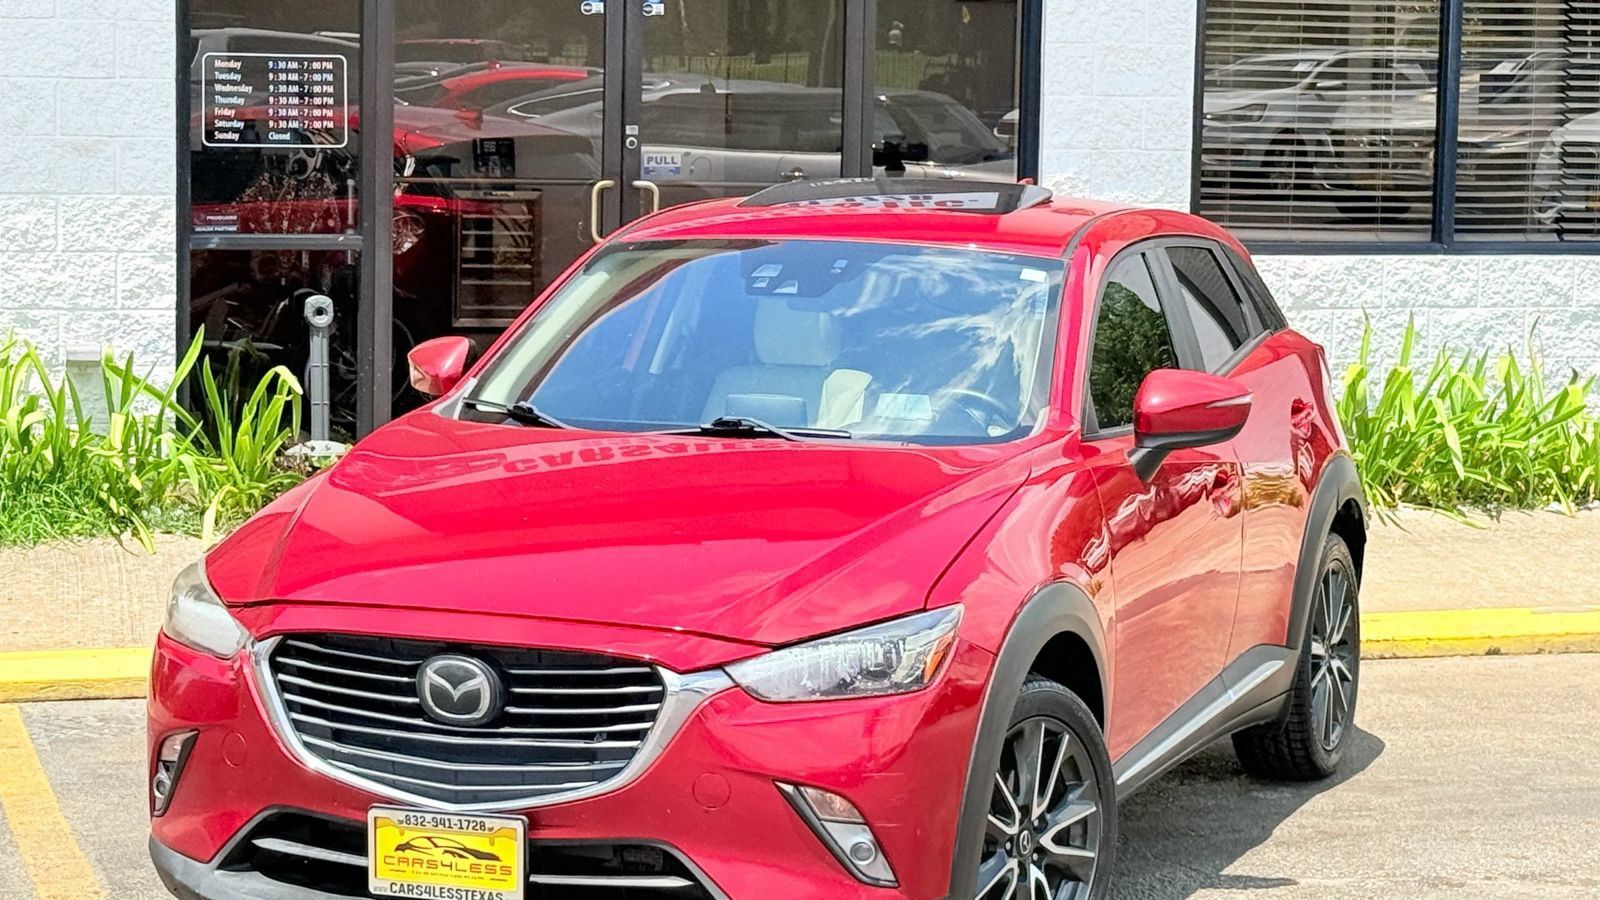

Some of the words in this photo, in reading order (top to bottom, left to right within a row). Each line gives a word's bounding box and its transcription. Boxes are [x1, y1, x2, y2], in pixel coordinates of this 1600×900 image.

[214, 59, 242, 70] Monday
[287, 61, 298, 70] AM
[322, 61, 333, 70] PM
[214, 72, 242, 82] Tuesday
[288, 73, 299, 81] AM
[323, 73, 333, 81] PM
[214, 84, 254, 94] Wednesday
[288, 85, 299, 93] AM
[323, 85, 334, 93] PM
[214, 96, 245, 106] Thursday
[288, 97, 299, 105] AM
[323, 97, 334, 105] PM
[214, 108, 236, 118] Friday
[288, 109, 299, 117] AM
[323, 109, 333, 117] PM
[214, 120, 244, 130] Saturday
[214, 131, 240, 141] Sunday
[268, 132, 290, 140] Closed
[646, 156, 678, 165] PULL
[404, 814, 486, 832] 832-941-1728
[384, 855, 512, 876] CARS4LESS
[390, 882, 503, 900] CARS4LESSTEXAS
